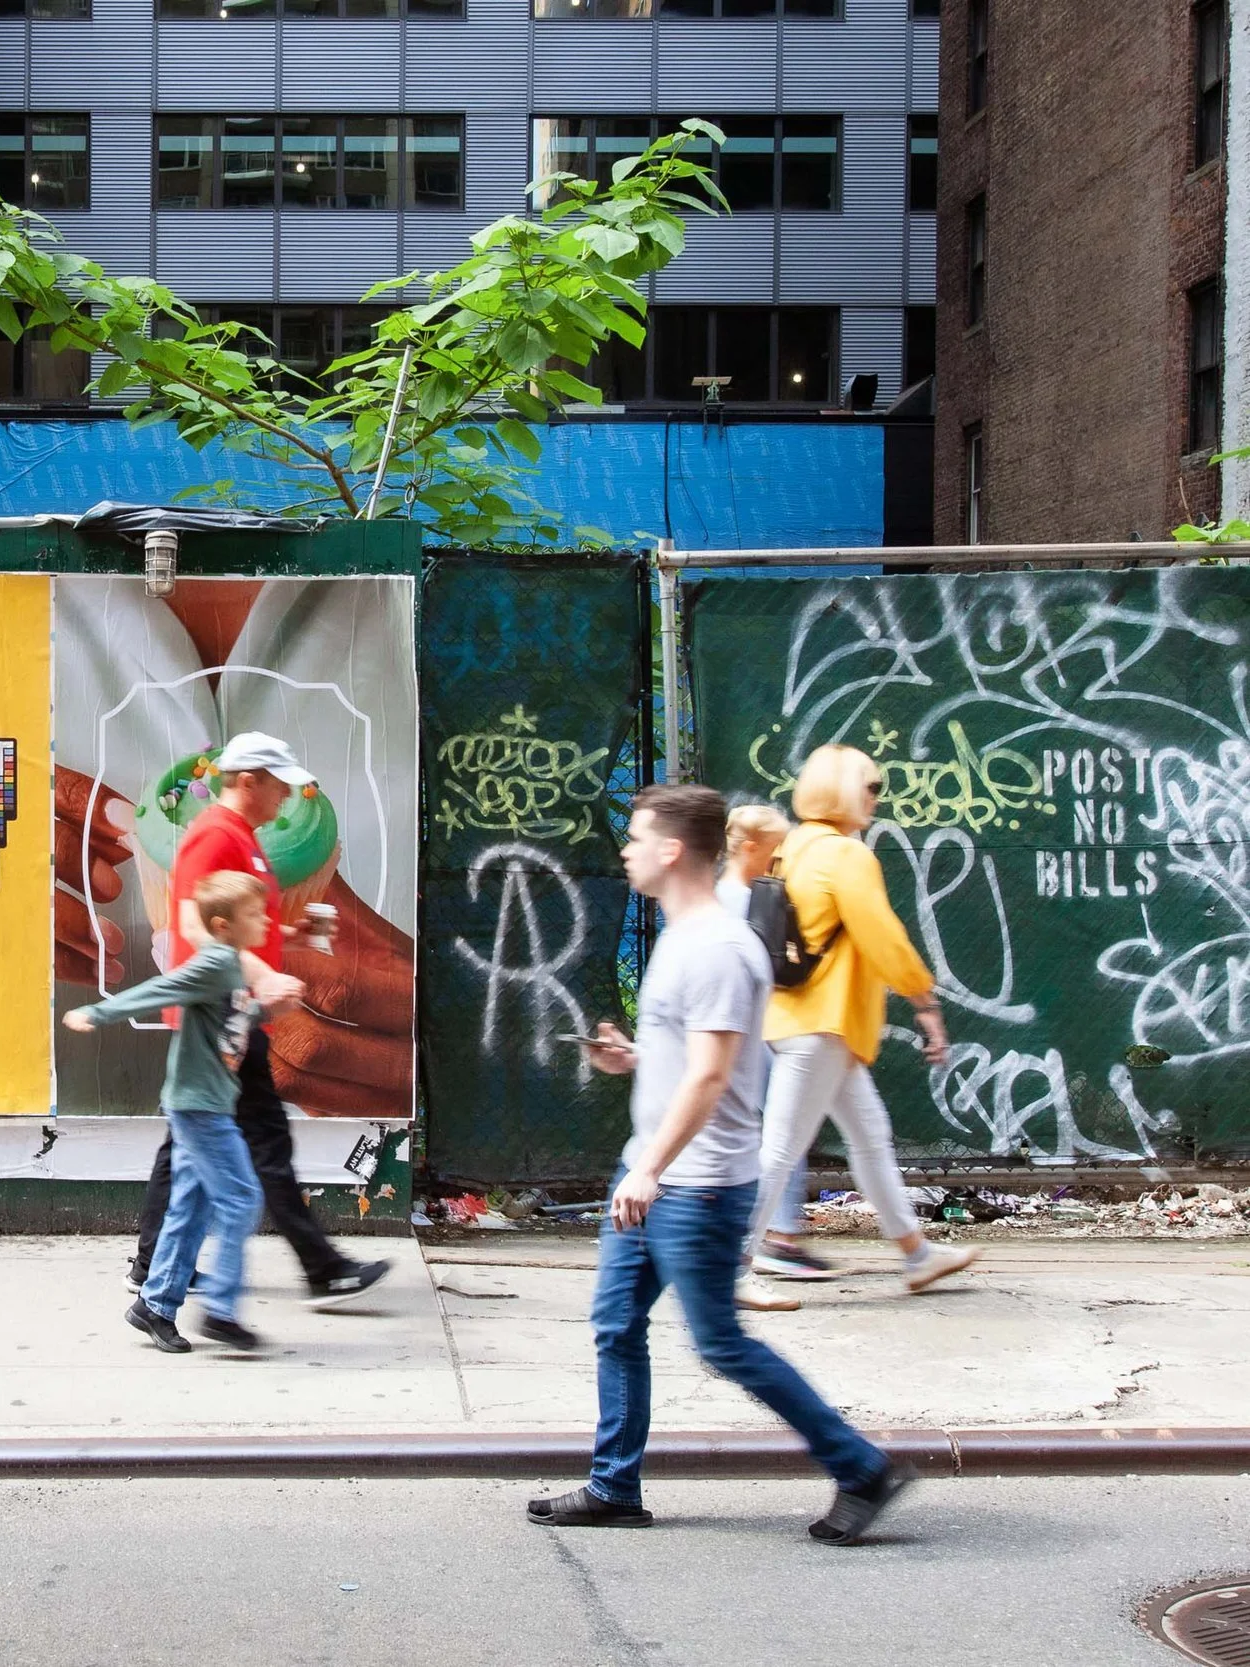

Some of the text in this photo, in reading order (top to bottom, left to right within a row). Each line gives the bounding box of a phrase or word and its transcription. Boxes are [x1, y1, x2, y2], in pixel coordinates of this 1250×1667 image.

[1043, 748, 1151, 796] POST
[1074, 799, 1126, 845] NO
[1036, 850, 1158, 898] BILLS
